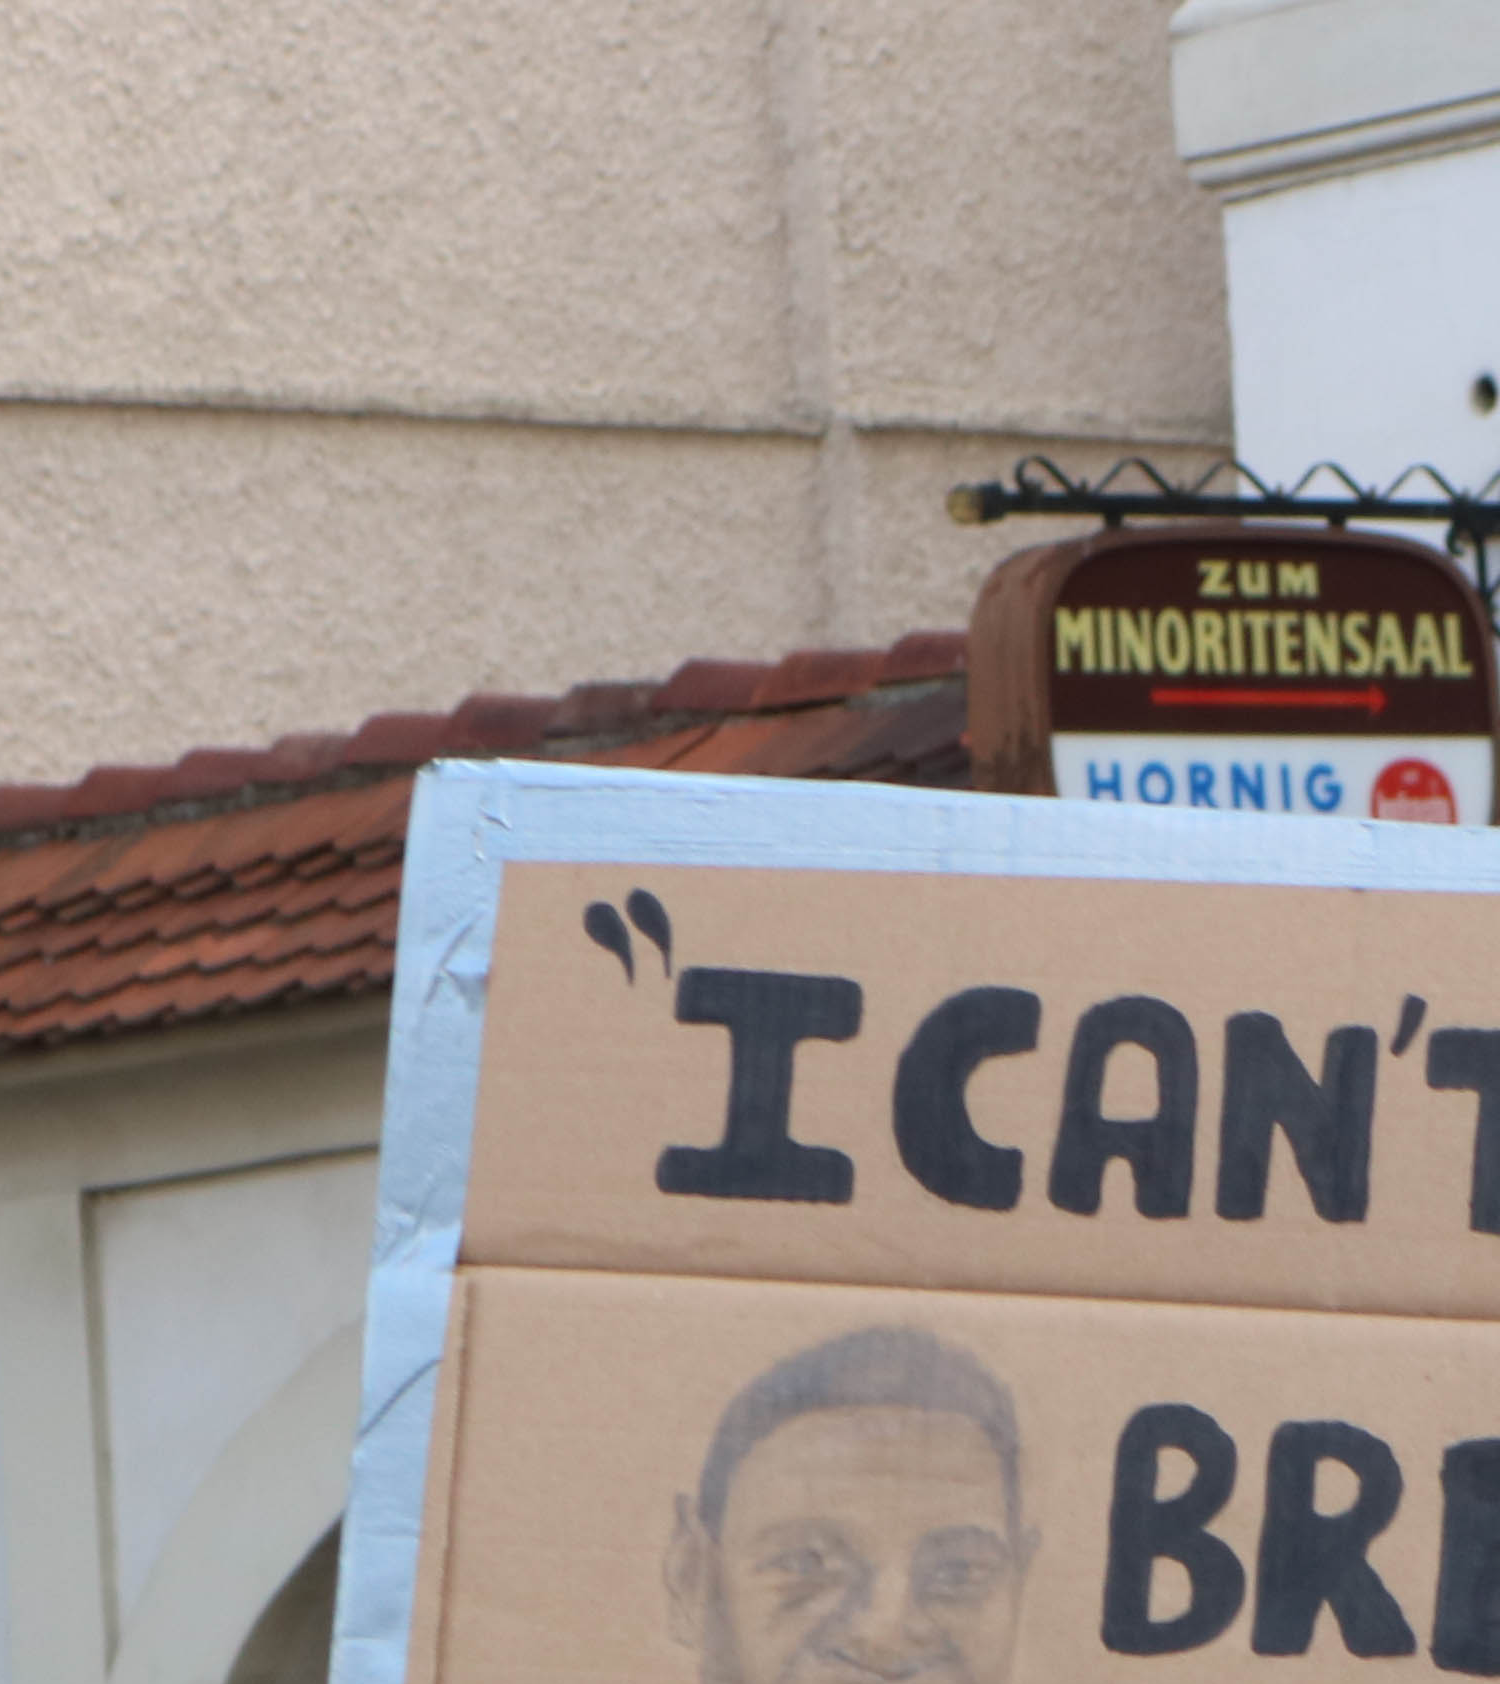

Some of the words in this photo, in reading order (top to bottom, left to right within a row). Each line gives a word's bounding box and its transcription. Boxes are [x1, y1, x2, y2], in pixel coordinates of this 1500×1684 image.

[1198, 559, 1320, 597] ZUM
[1053, 606, 1473, 678] MINORITENSAAL
[1086, 761, 1345, 812] HORNIG
